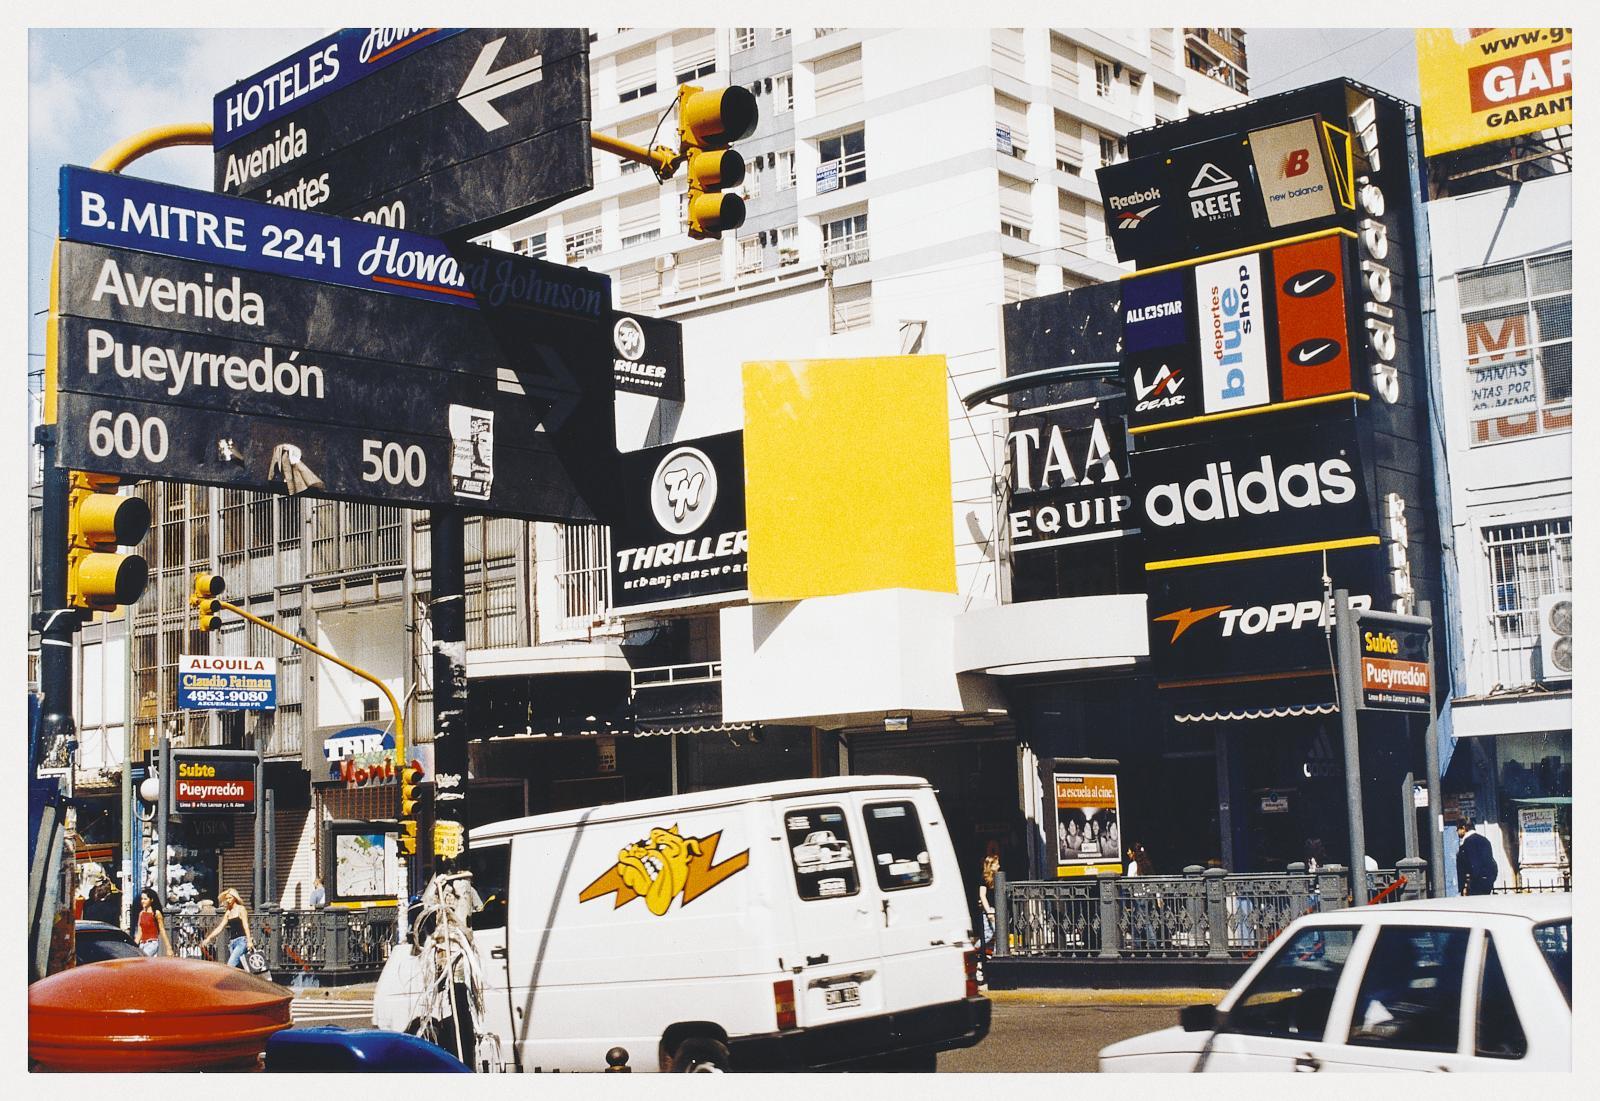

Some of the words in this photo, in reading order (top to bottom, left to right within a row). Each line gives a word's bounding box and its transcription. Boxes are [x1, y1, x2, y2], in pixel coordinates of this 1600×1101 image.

[1480, 28, 1572, 55] www.g
[226, 43, 340, 132] HOTELES
[223, 122, 307, 192] Avenida
[1109, 187, 1161, 210] Reebok
[1190, 191, 1242, 219] REEF
[1269, 191, 1287, 202] new
[1288, 183, 1324, 199] balance
[261, 224, 342, 268] 2241
[91, 258, 265, 327] Avenida
[1238, 264, 1252, 334] shop
[1210, 285, 1223, 360] deportes
[1219, 287, 1246, 400] blue
[87, 328, 325, 399] Pueyrredón
[613, 358, 667, 379] RILLER
[1508, 381, 1531, 395] POR
[1135, 395, 1185, 412] GEAR
[87, 410, 169, 463] 600
[362, 439, 427, 488] 500
[1145, 454, 1356, 527] adidas
[1009, 495, 1132, 539] EQUIP
[616, 529, 749, 573] THRILLER
[1364, 631, 1399, 655] Subte
[190, 659, 265, 670] ALQUILA
[1366, 662, 1427, 689] Pueyrredón
[183, 674, 227, 687] Claudio
[187, 690, 268, 702] 4953-9080
[179, 763, 216, 777] Subte
[179, 782, 244, 799] Pueyrredón
[1057, 784, 1067, 798] La
[1067, 784, 1091, 798] escuela
[1091, 785, 1098, 798] al
[1098, 785, 1115, 798] cine.
